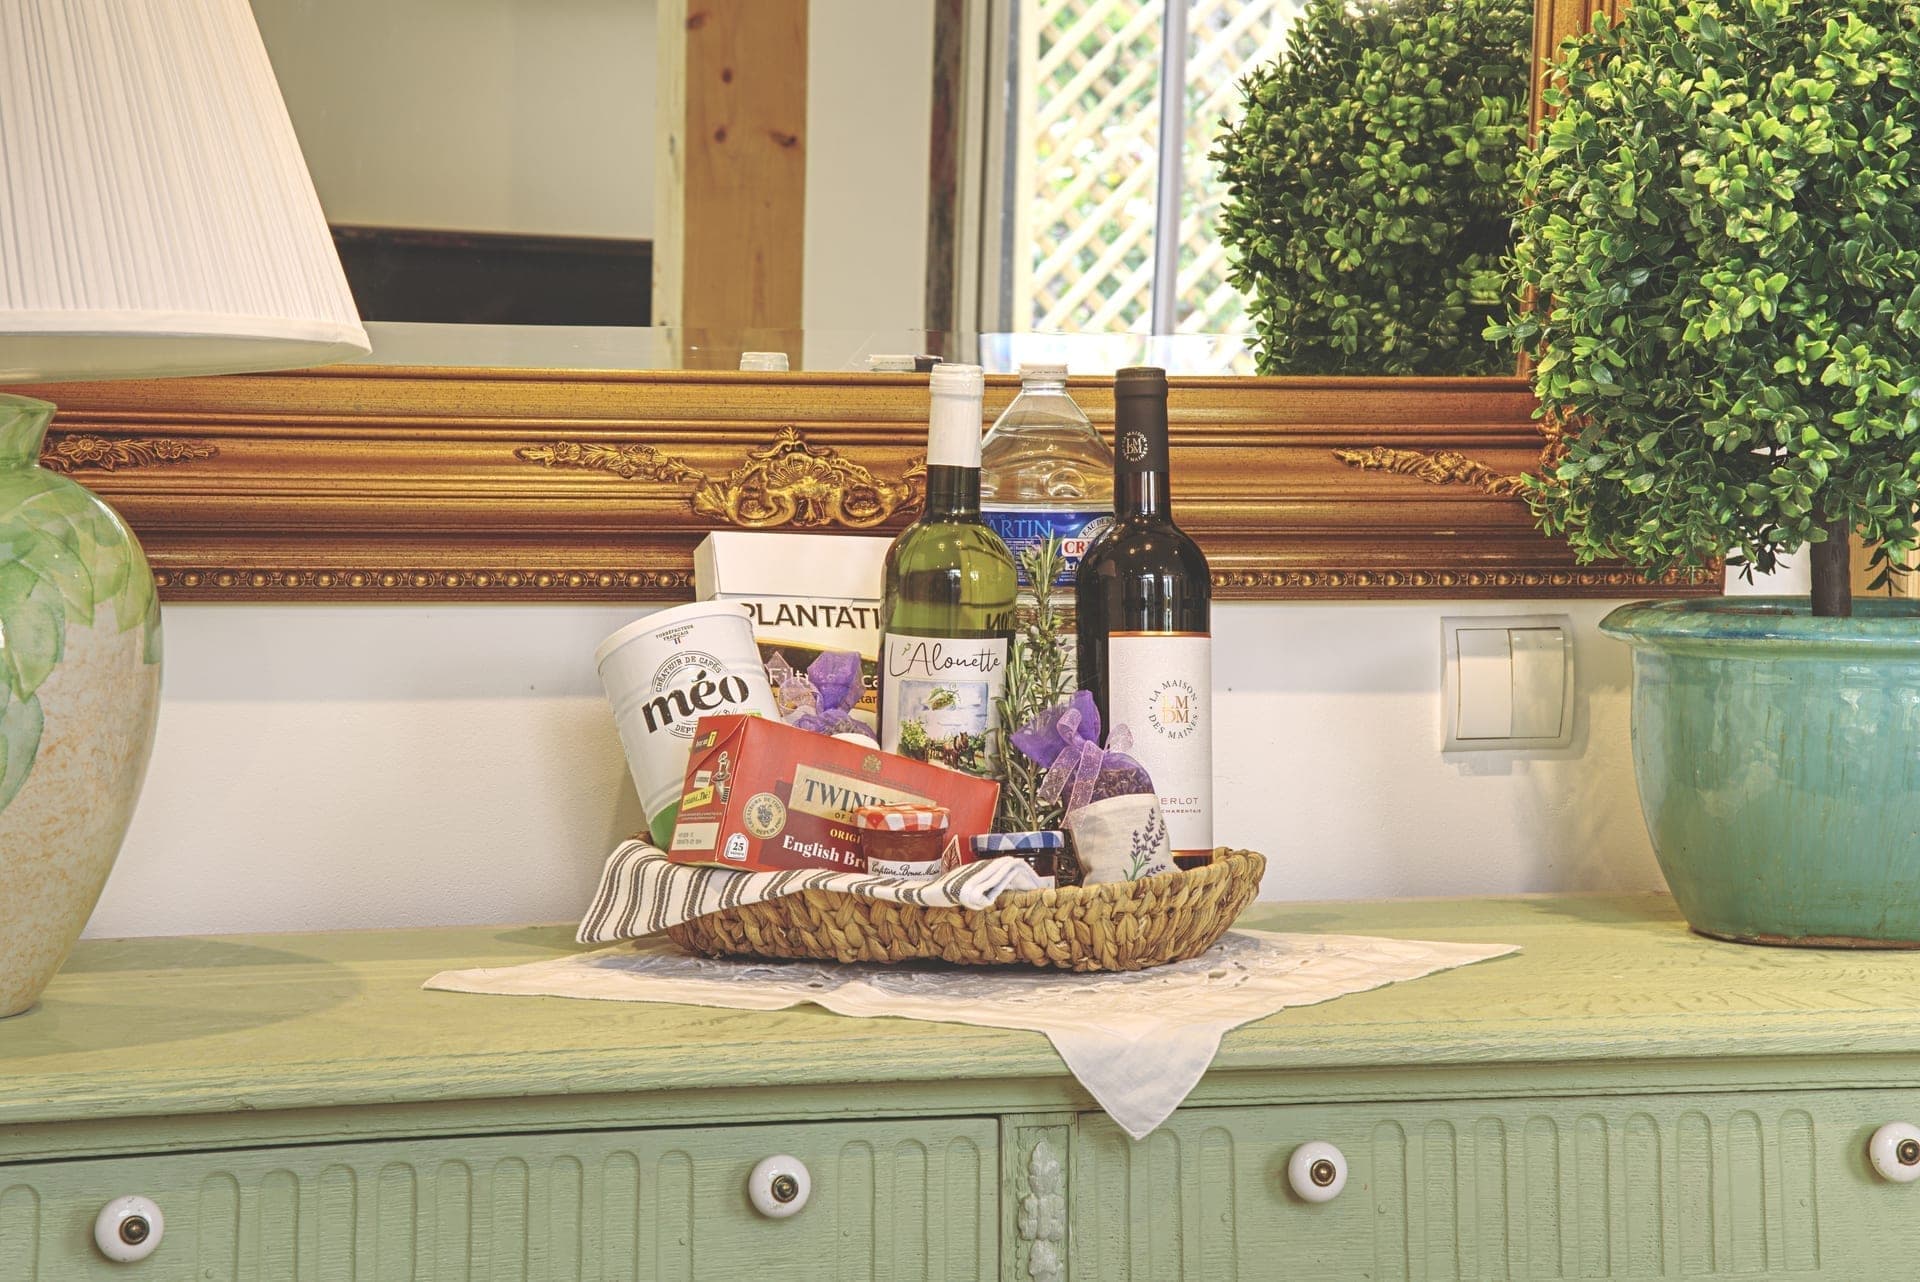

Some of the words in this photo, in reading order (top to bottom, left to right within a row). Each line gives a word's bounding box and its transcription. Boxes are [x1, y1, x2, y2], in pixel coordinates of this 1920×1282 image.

[985, 519, 1051, 538] ARTIN
[1064, 541, 1091, 554] CR
[685, 655, 697, 664] DE
[1149, 690, 1161, 702] LA
[1161, 679, 1198, 702] MAISON
[641, 669, 750, 734] méo
[1148, 714, 1165, 734] DES
[1167, 713, 1199, 740] MAINES
[1160, 797, 1199, 805] ERLOT
[732, 841, 745, 852] 25
[782, 834, 840, 862] English
